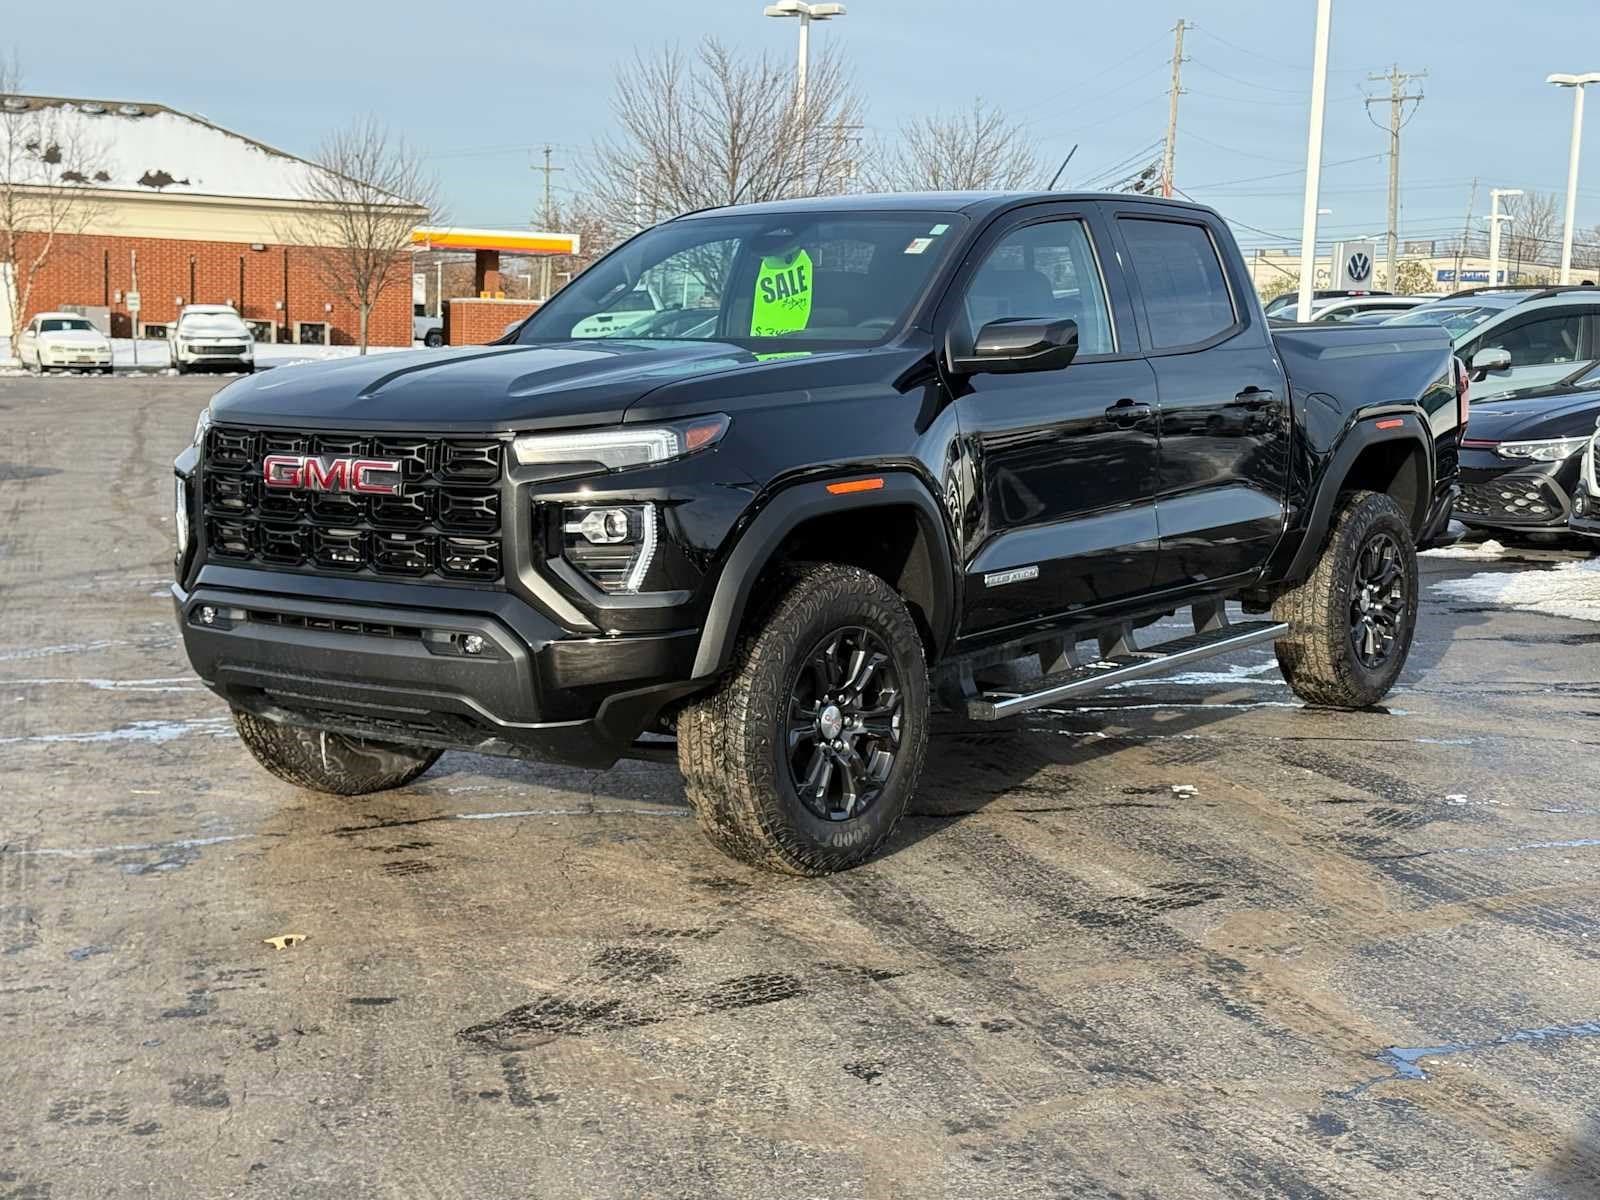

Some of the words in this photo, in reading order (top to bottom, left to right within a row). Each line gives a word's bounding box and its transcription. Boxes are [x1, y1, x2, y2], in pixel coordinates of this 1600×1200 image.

[760, 265, 808, 304] SALE
[1459, 270, 1501, 280] HYUNDI
[263, 454, 402, 497] GMC
